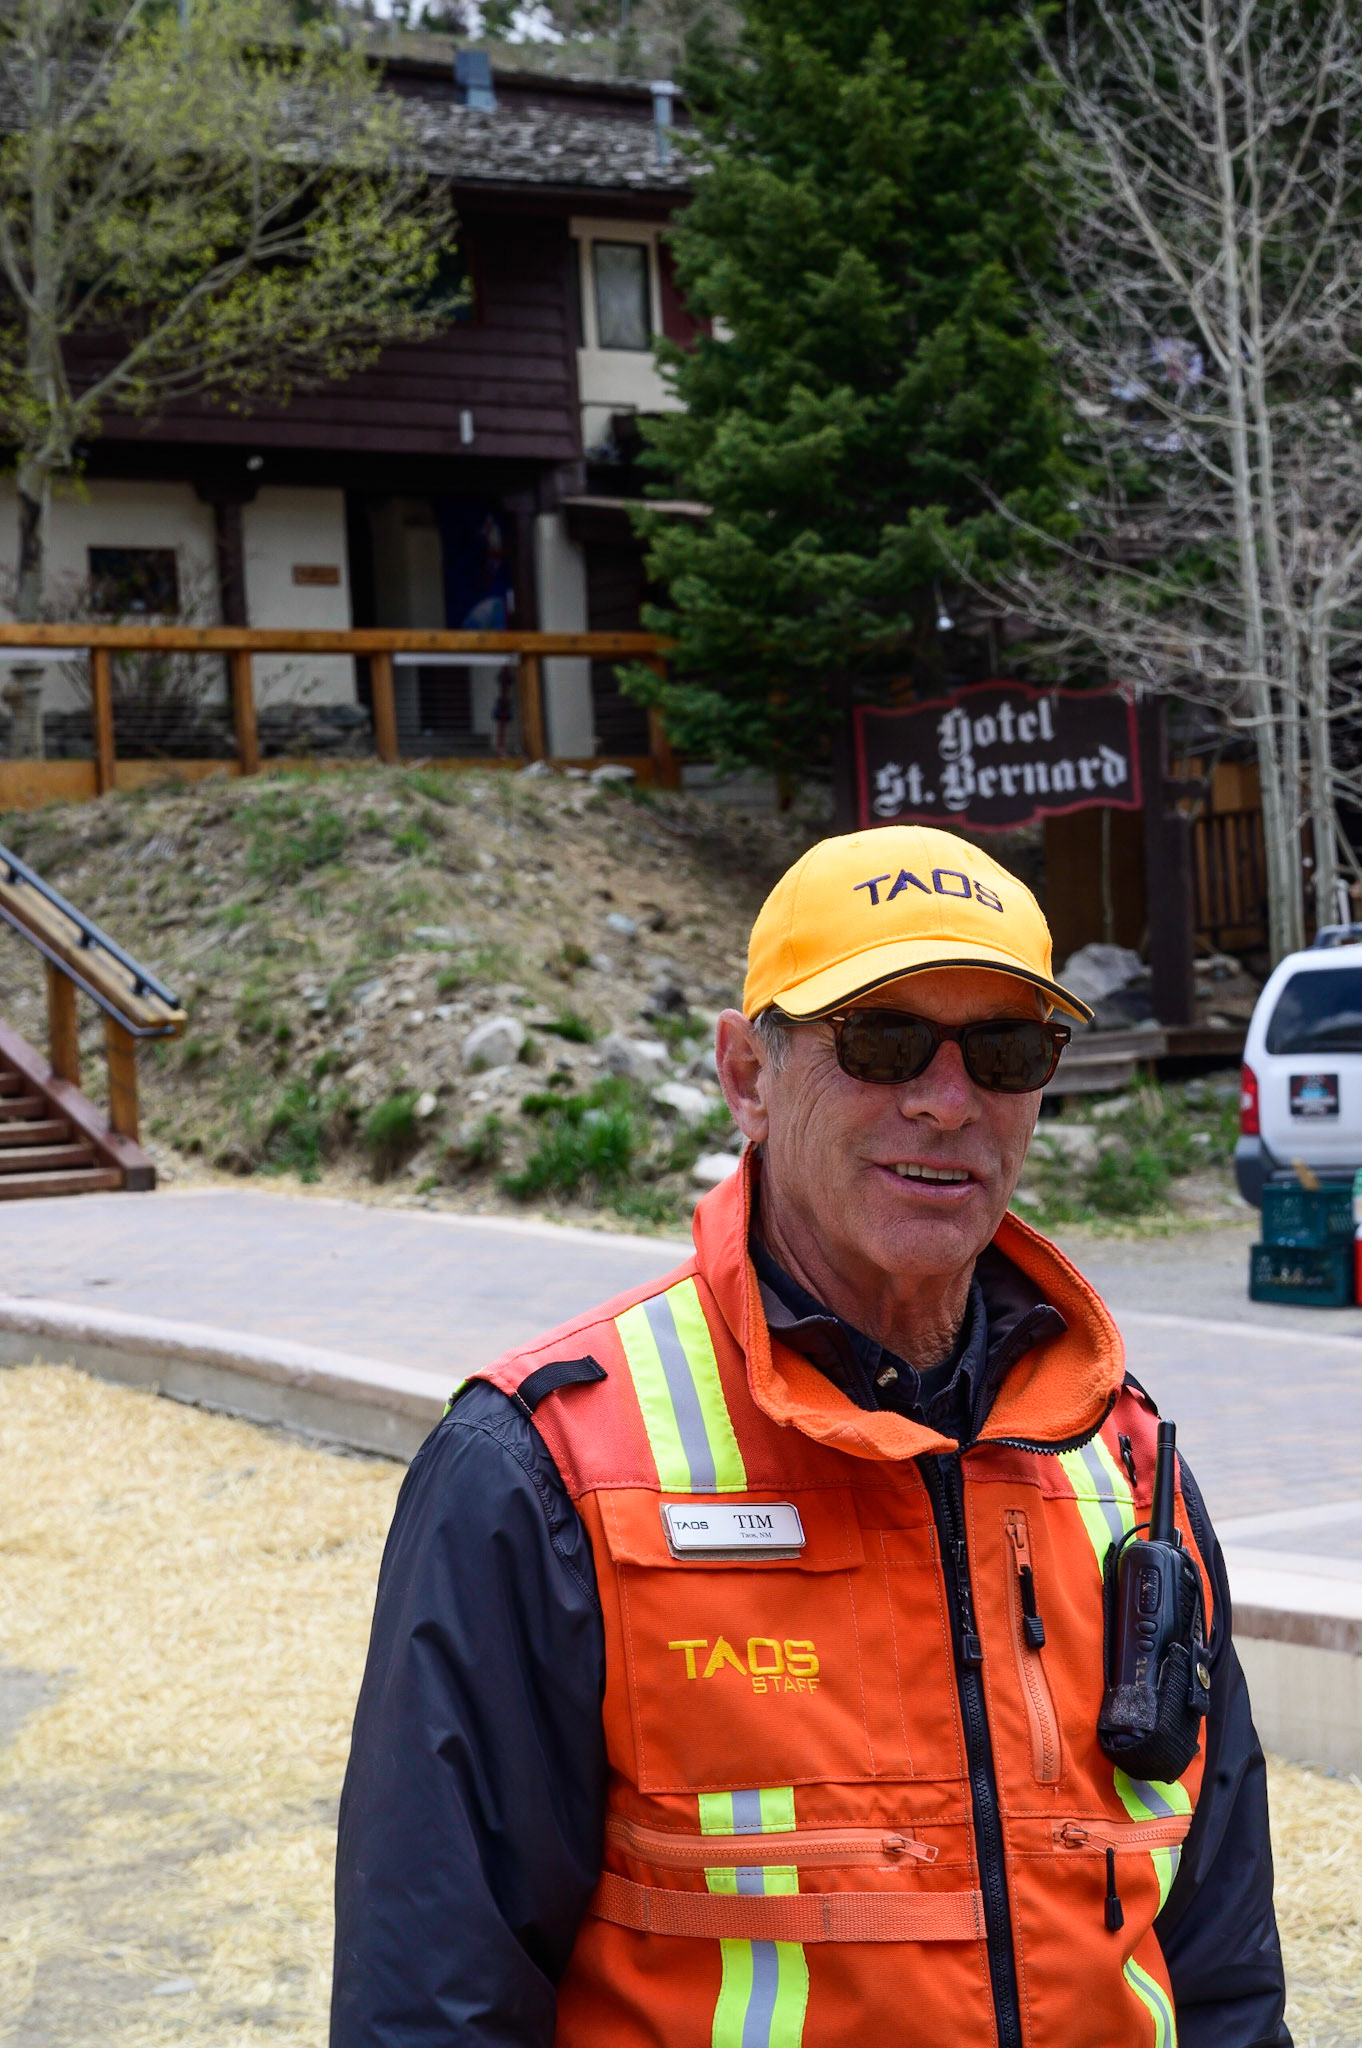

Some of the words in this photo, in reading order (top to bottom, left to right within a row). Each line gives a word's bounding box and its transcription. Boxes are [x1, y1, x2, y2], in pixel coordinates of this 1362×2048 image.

[936, 697, 1055, 761] Hotel
[872, 761, 936, 817] St.
[939, 743, 1128, 811] Bernard
[852, 868, 1005, 913] TAOS
[673, 1520, 710, 1530] TAOS
[733, 1514, 775, 1529] TIM
[740, 1531, 759, 1540] Taos,
[759, 1531, 772, 1539] NM
[668, 1635, 820, 1680] TAOS
[751, 1675, 821, 1695] STAFF
